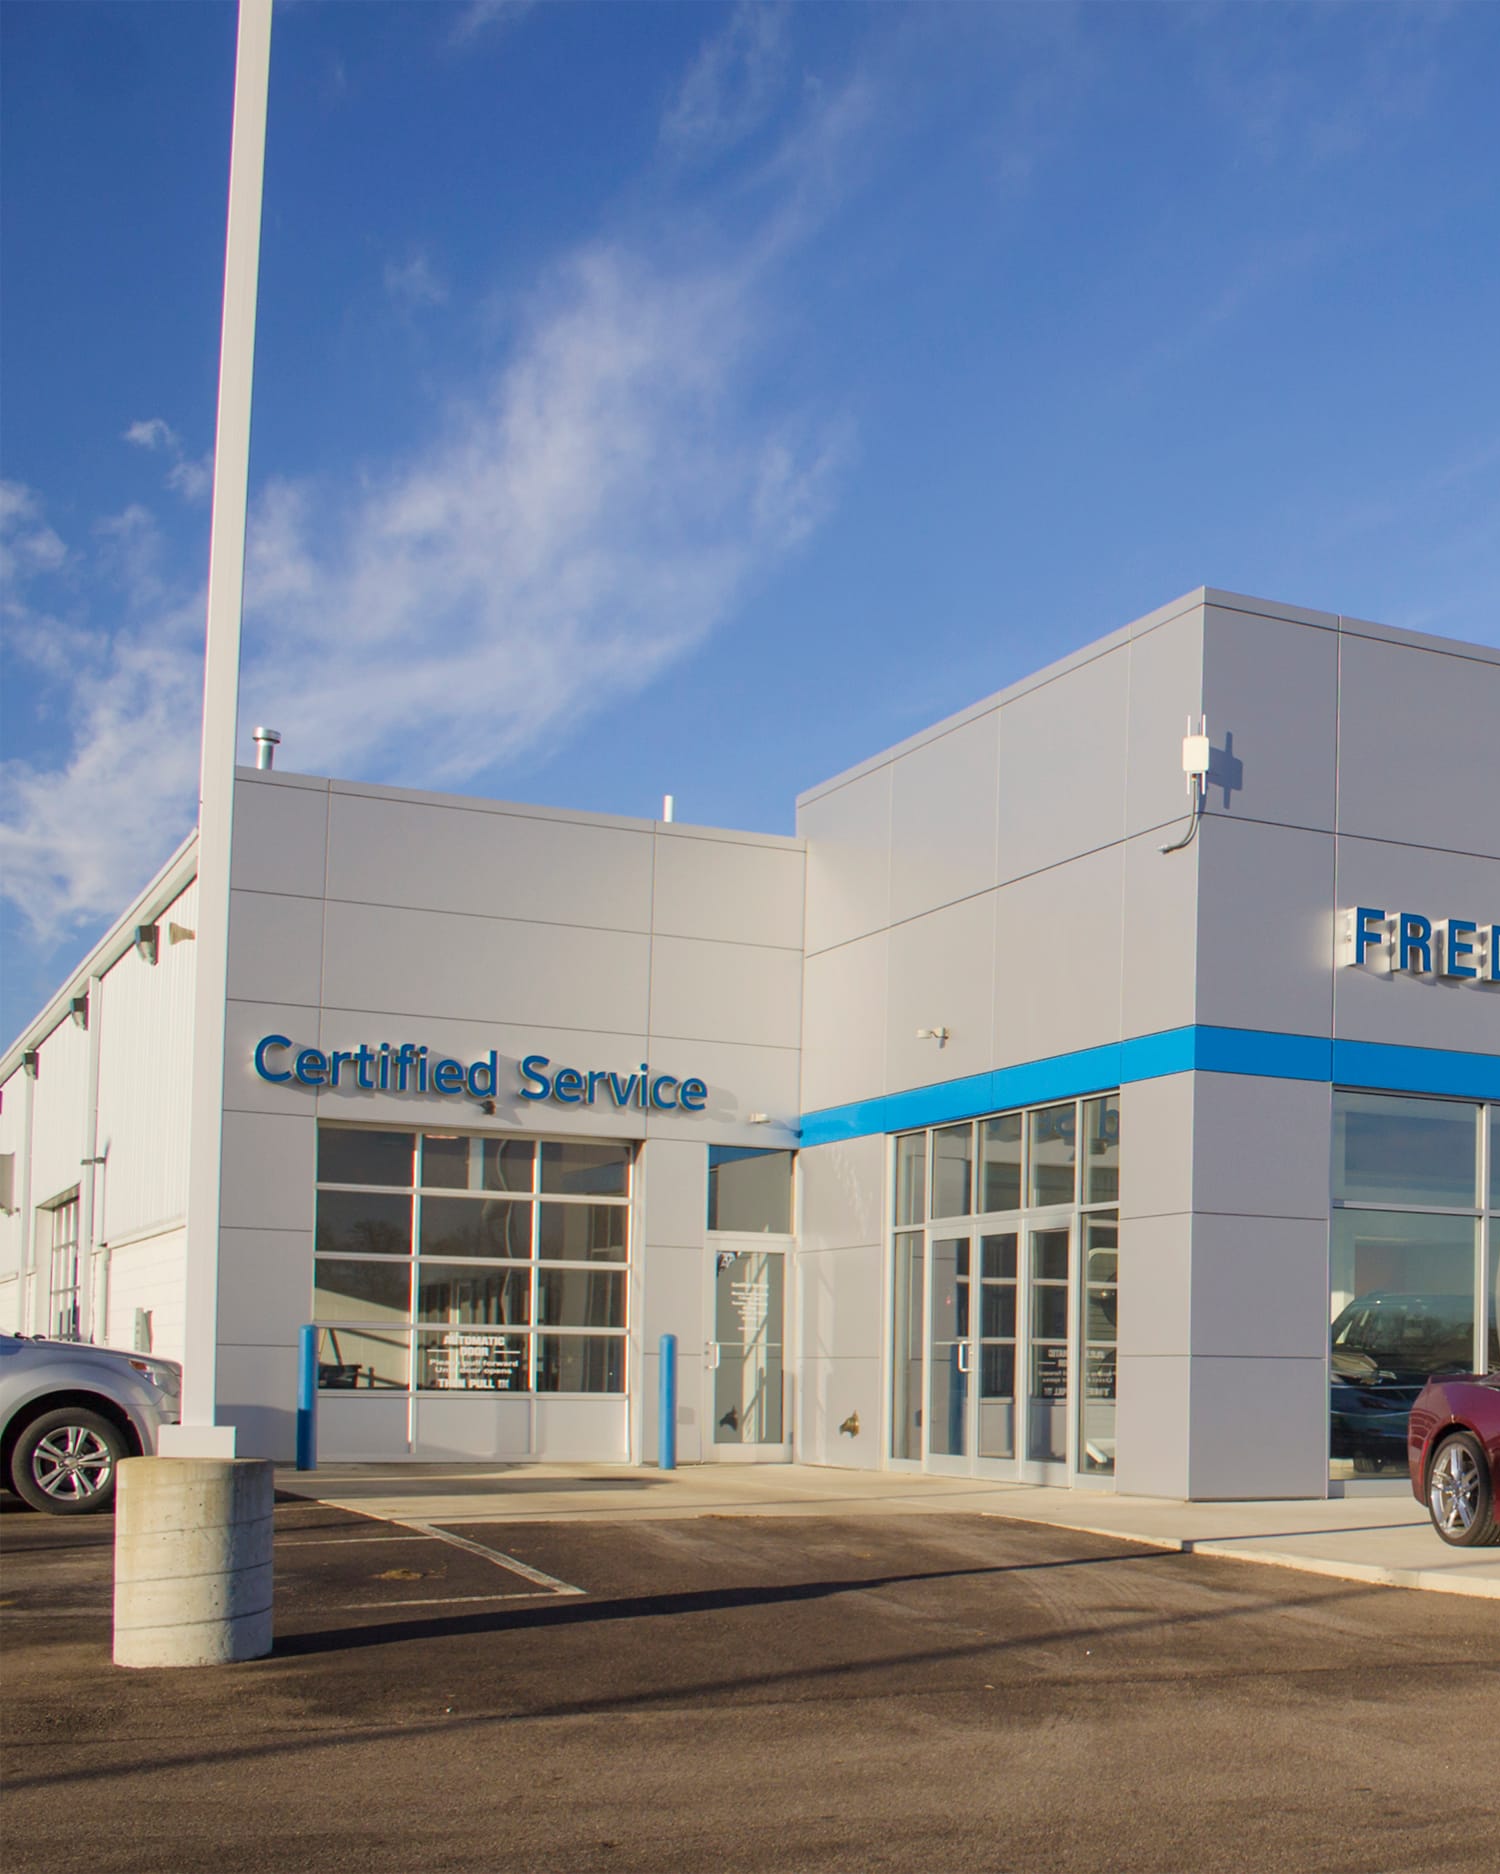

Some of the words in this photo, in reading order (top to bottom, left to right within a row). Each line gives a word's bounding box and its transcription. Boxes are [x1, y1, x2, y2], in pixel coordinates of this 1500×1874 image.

[253, 1034, 498, 1098] Certified
[519, 1054, 709, 1112] Service
[443, 1335, 506, 1346] AUTOMATIC
[460, 1346, 489, 1357] DOOR
[429, 1359, 459, 1368] Plea
[483, 1360, 519, 1368] forward
[483, 1367, 513, 1375] opens
[437, 1378, 467, 1389] THN
[467, 1379, 496, 1389] PULL
